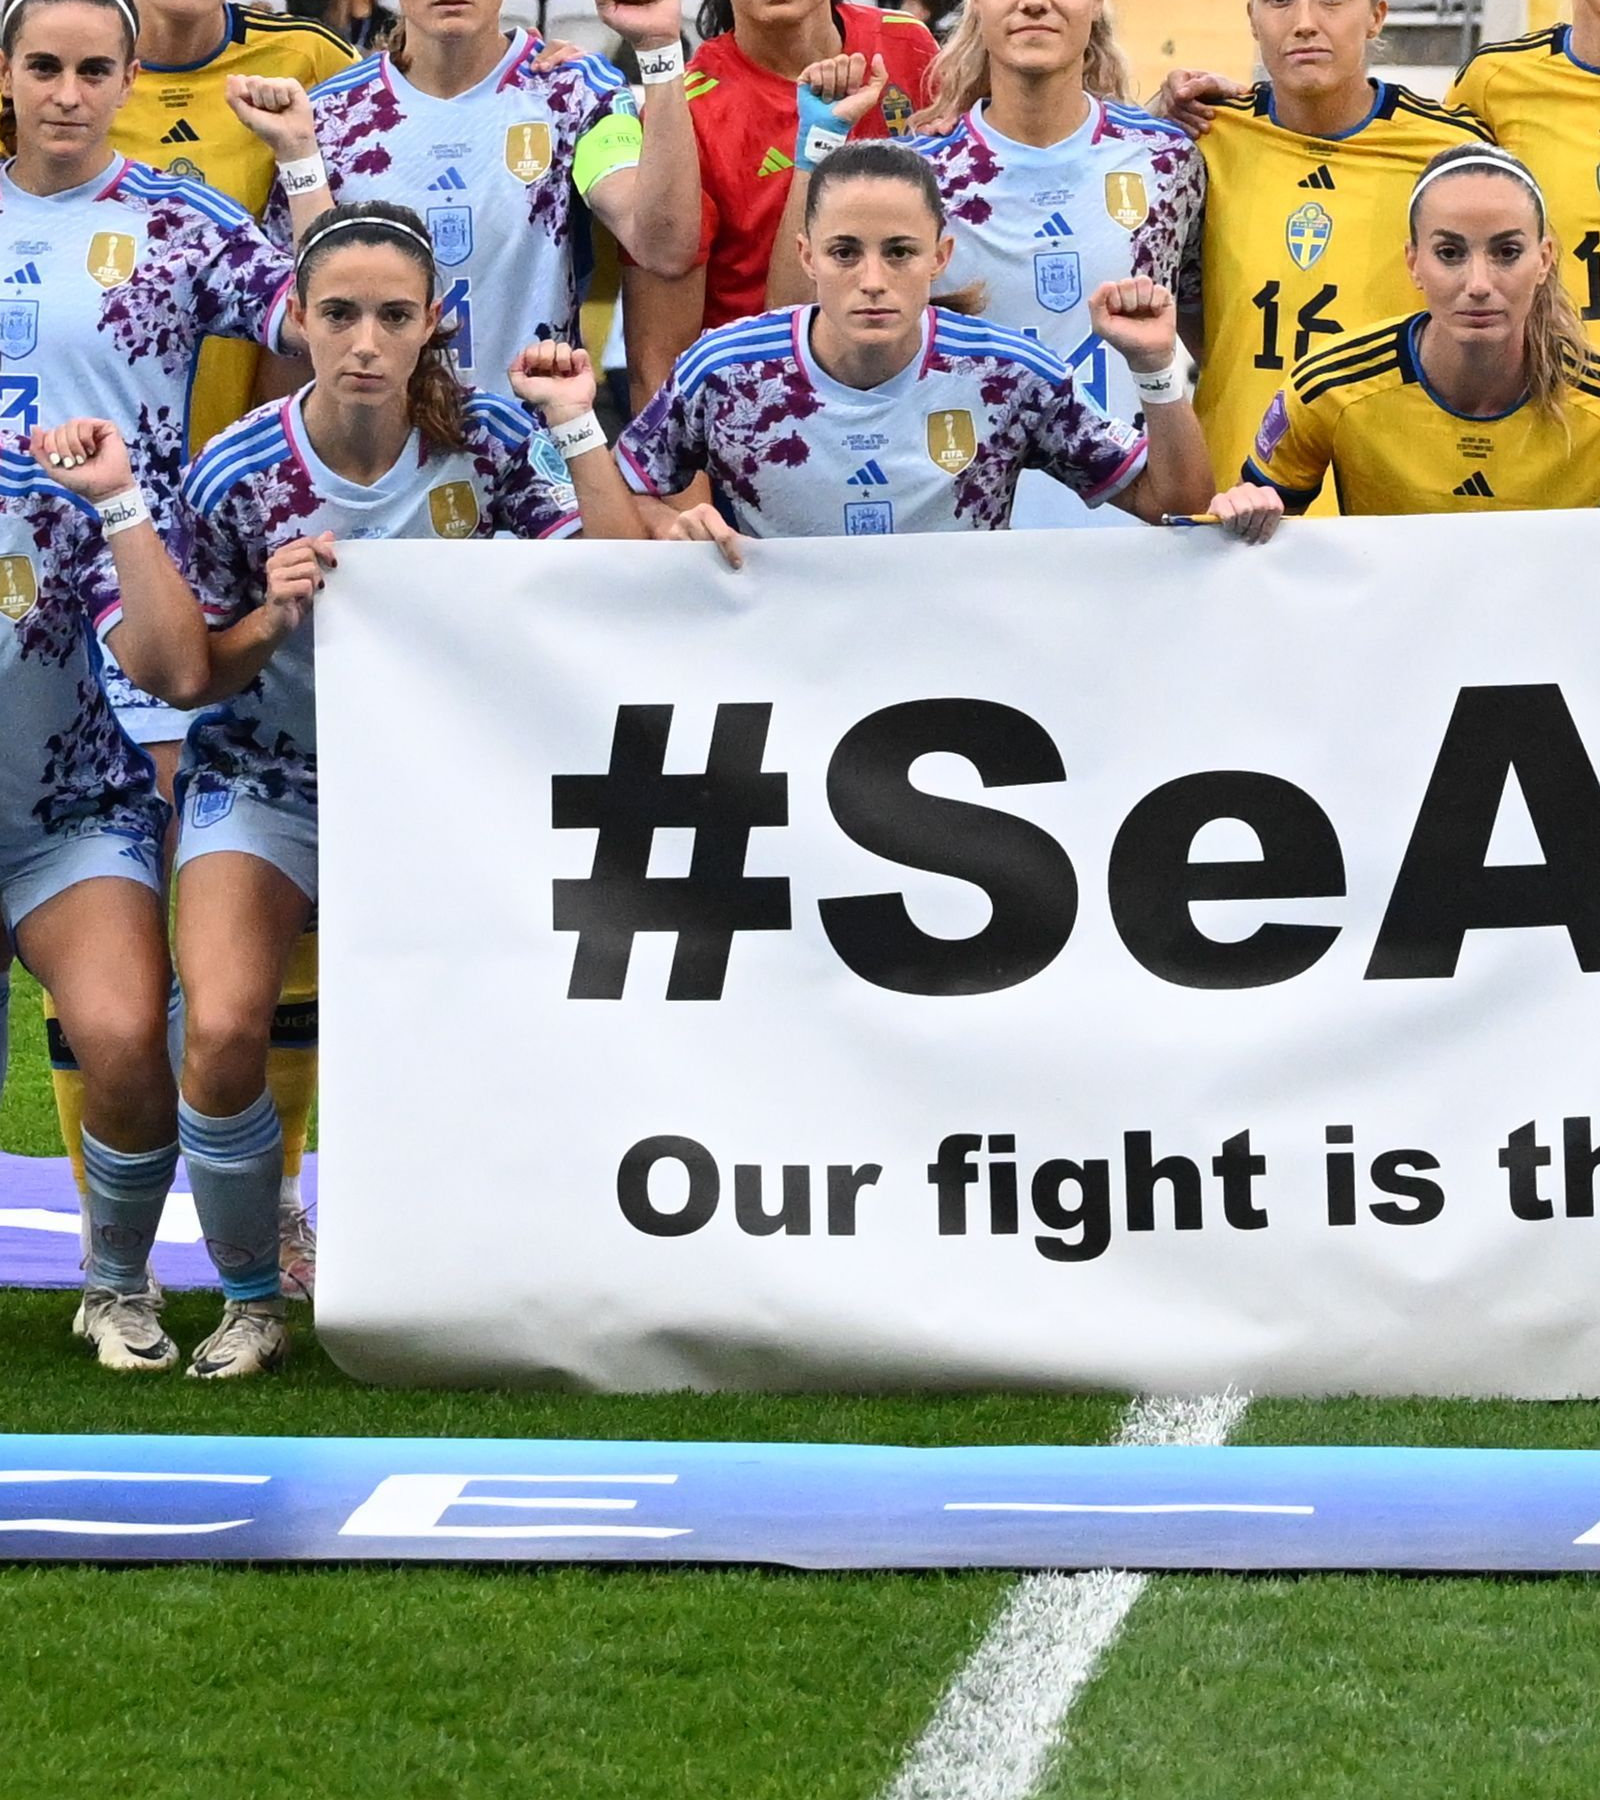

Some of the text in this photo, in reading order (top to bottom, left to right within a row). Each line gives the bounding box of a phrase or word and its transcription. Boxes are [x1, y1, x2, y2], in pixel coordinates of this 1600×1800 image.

[618, 1135, 882, 1237] Our
[928, 1130, 1269, 1262] fight
[1326, 1125, 1445, 1226] is
